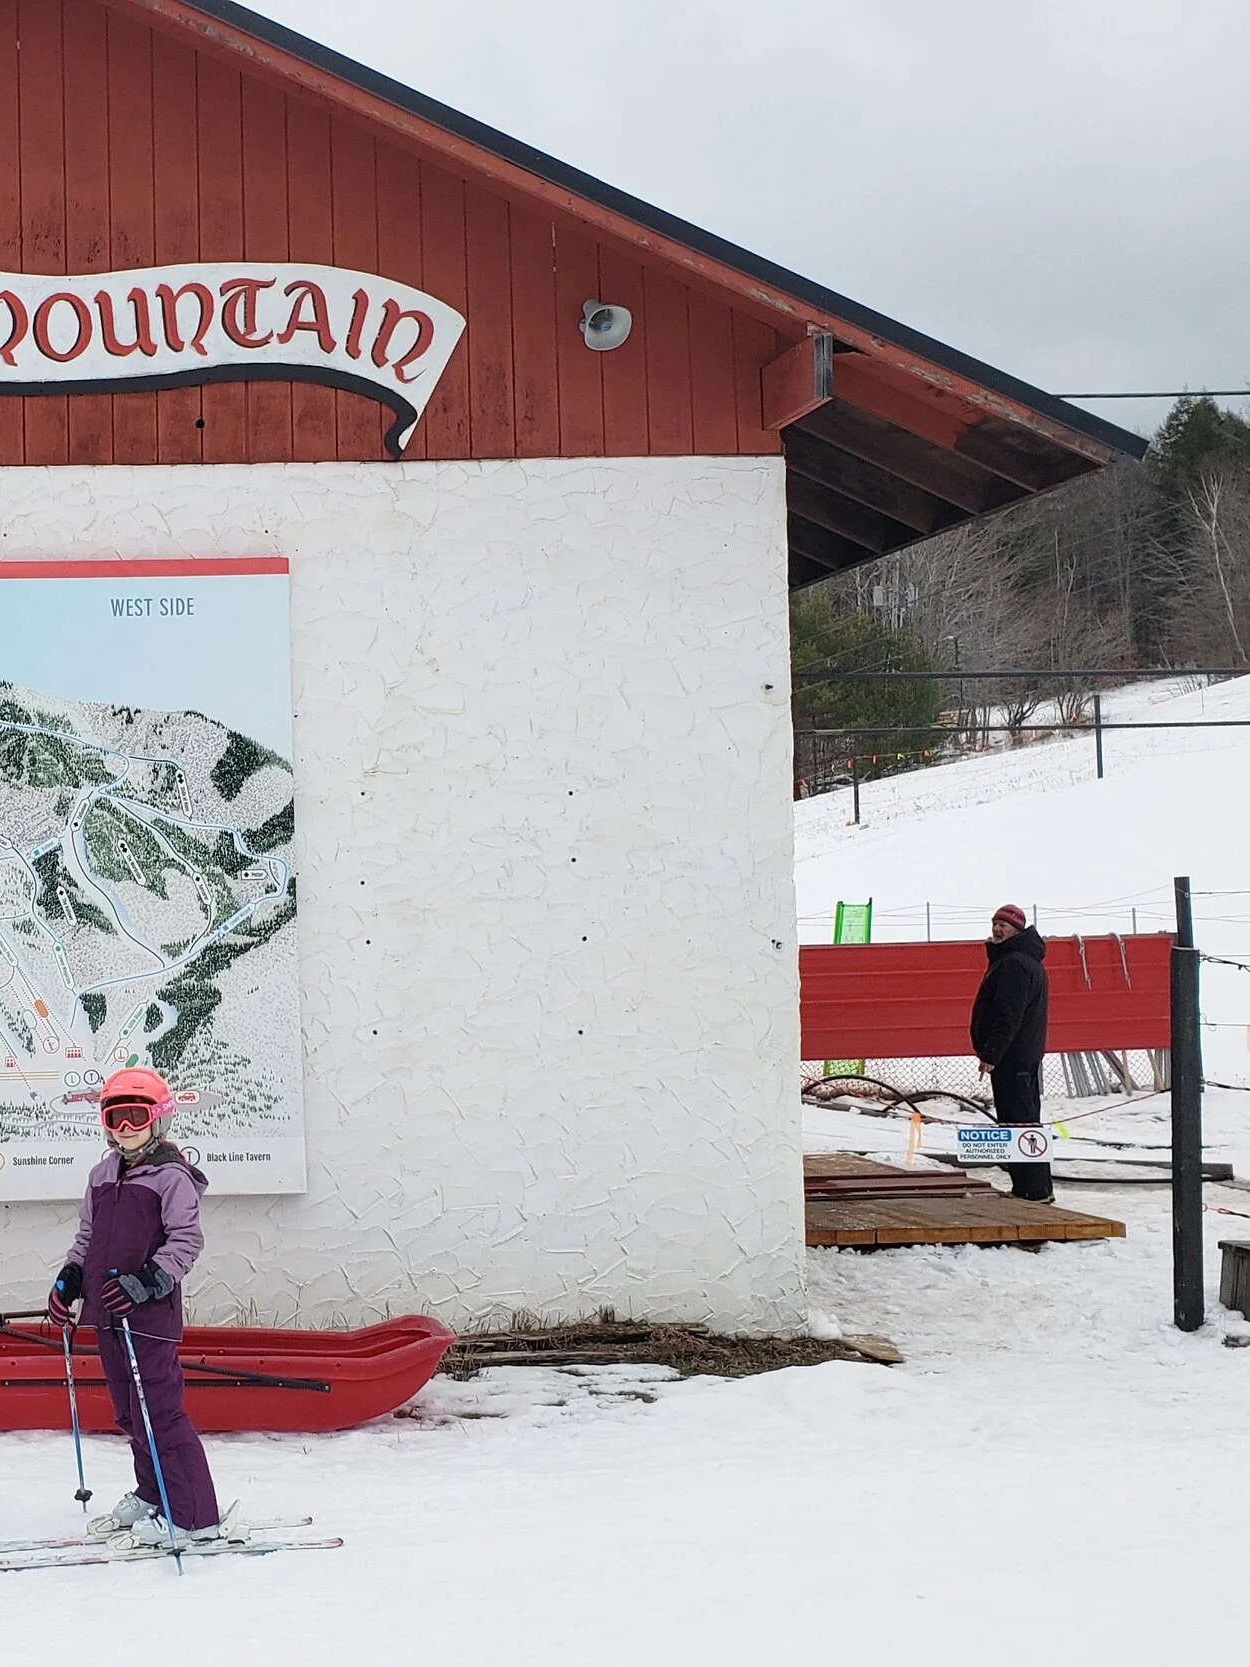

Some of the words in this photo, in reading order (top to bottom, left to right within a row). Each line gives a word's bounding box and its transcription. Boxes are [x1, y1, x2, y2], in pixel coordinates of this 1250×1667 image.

[110, 598, 153, 617] WEST
[159, 597, 194, 616] SIDE
[125, 853, 133, 862] The
[960, 1130, 1009, 1140] NOTICE
[13, 1156, 47, 1166] Sunshine
[49, 1155, 74, 1166] Corner
[207, 1152, 227, 1162] Black
[228, 1151, 244, 1162] Line
[245, 1151, 271, 1162] Tavern
